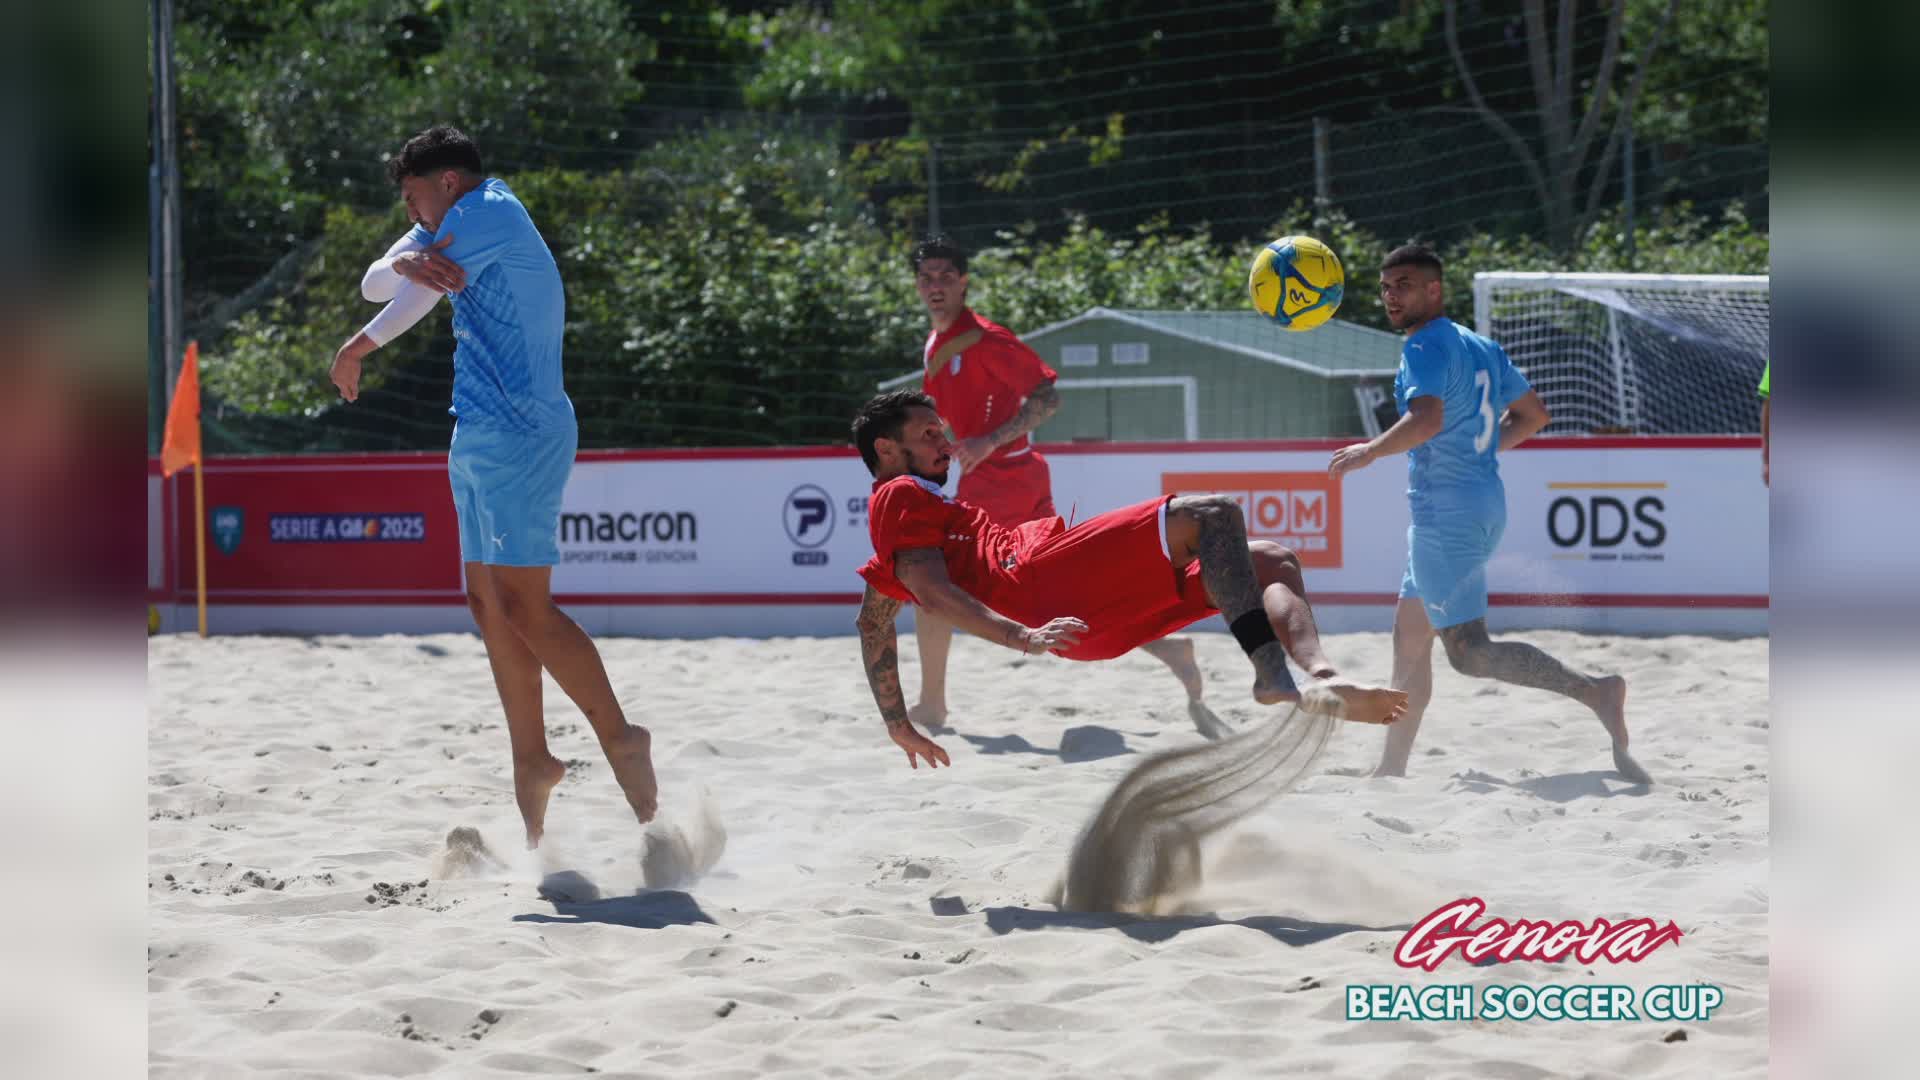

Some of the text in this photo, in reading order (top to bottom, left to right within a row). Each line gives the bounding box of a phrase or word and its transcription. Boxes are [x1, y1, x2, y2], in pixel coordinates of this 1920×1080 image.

[1474, 369, 1495, 454] 3
[270, 516, 320, 539] SERIE
[323, 517, 337, 539] A
[380, 516, 425, 539] 2025
[560, 511, 697, 543] macron
[1547, 495, 1667, 548] ODS
